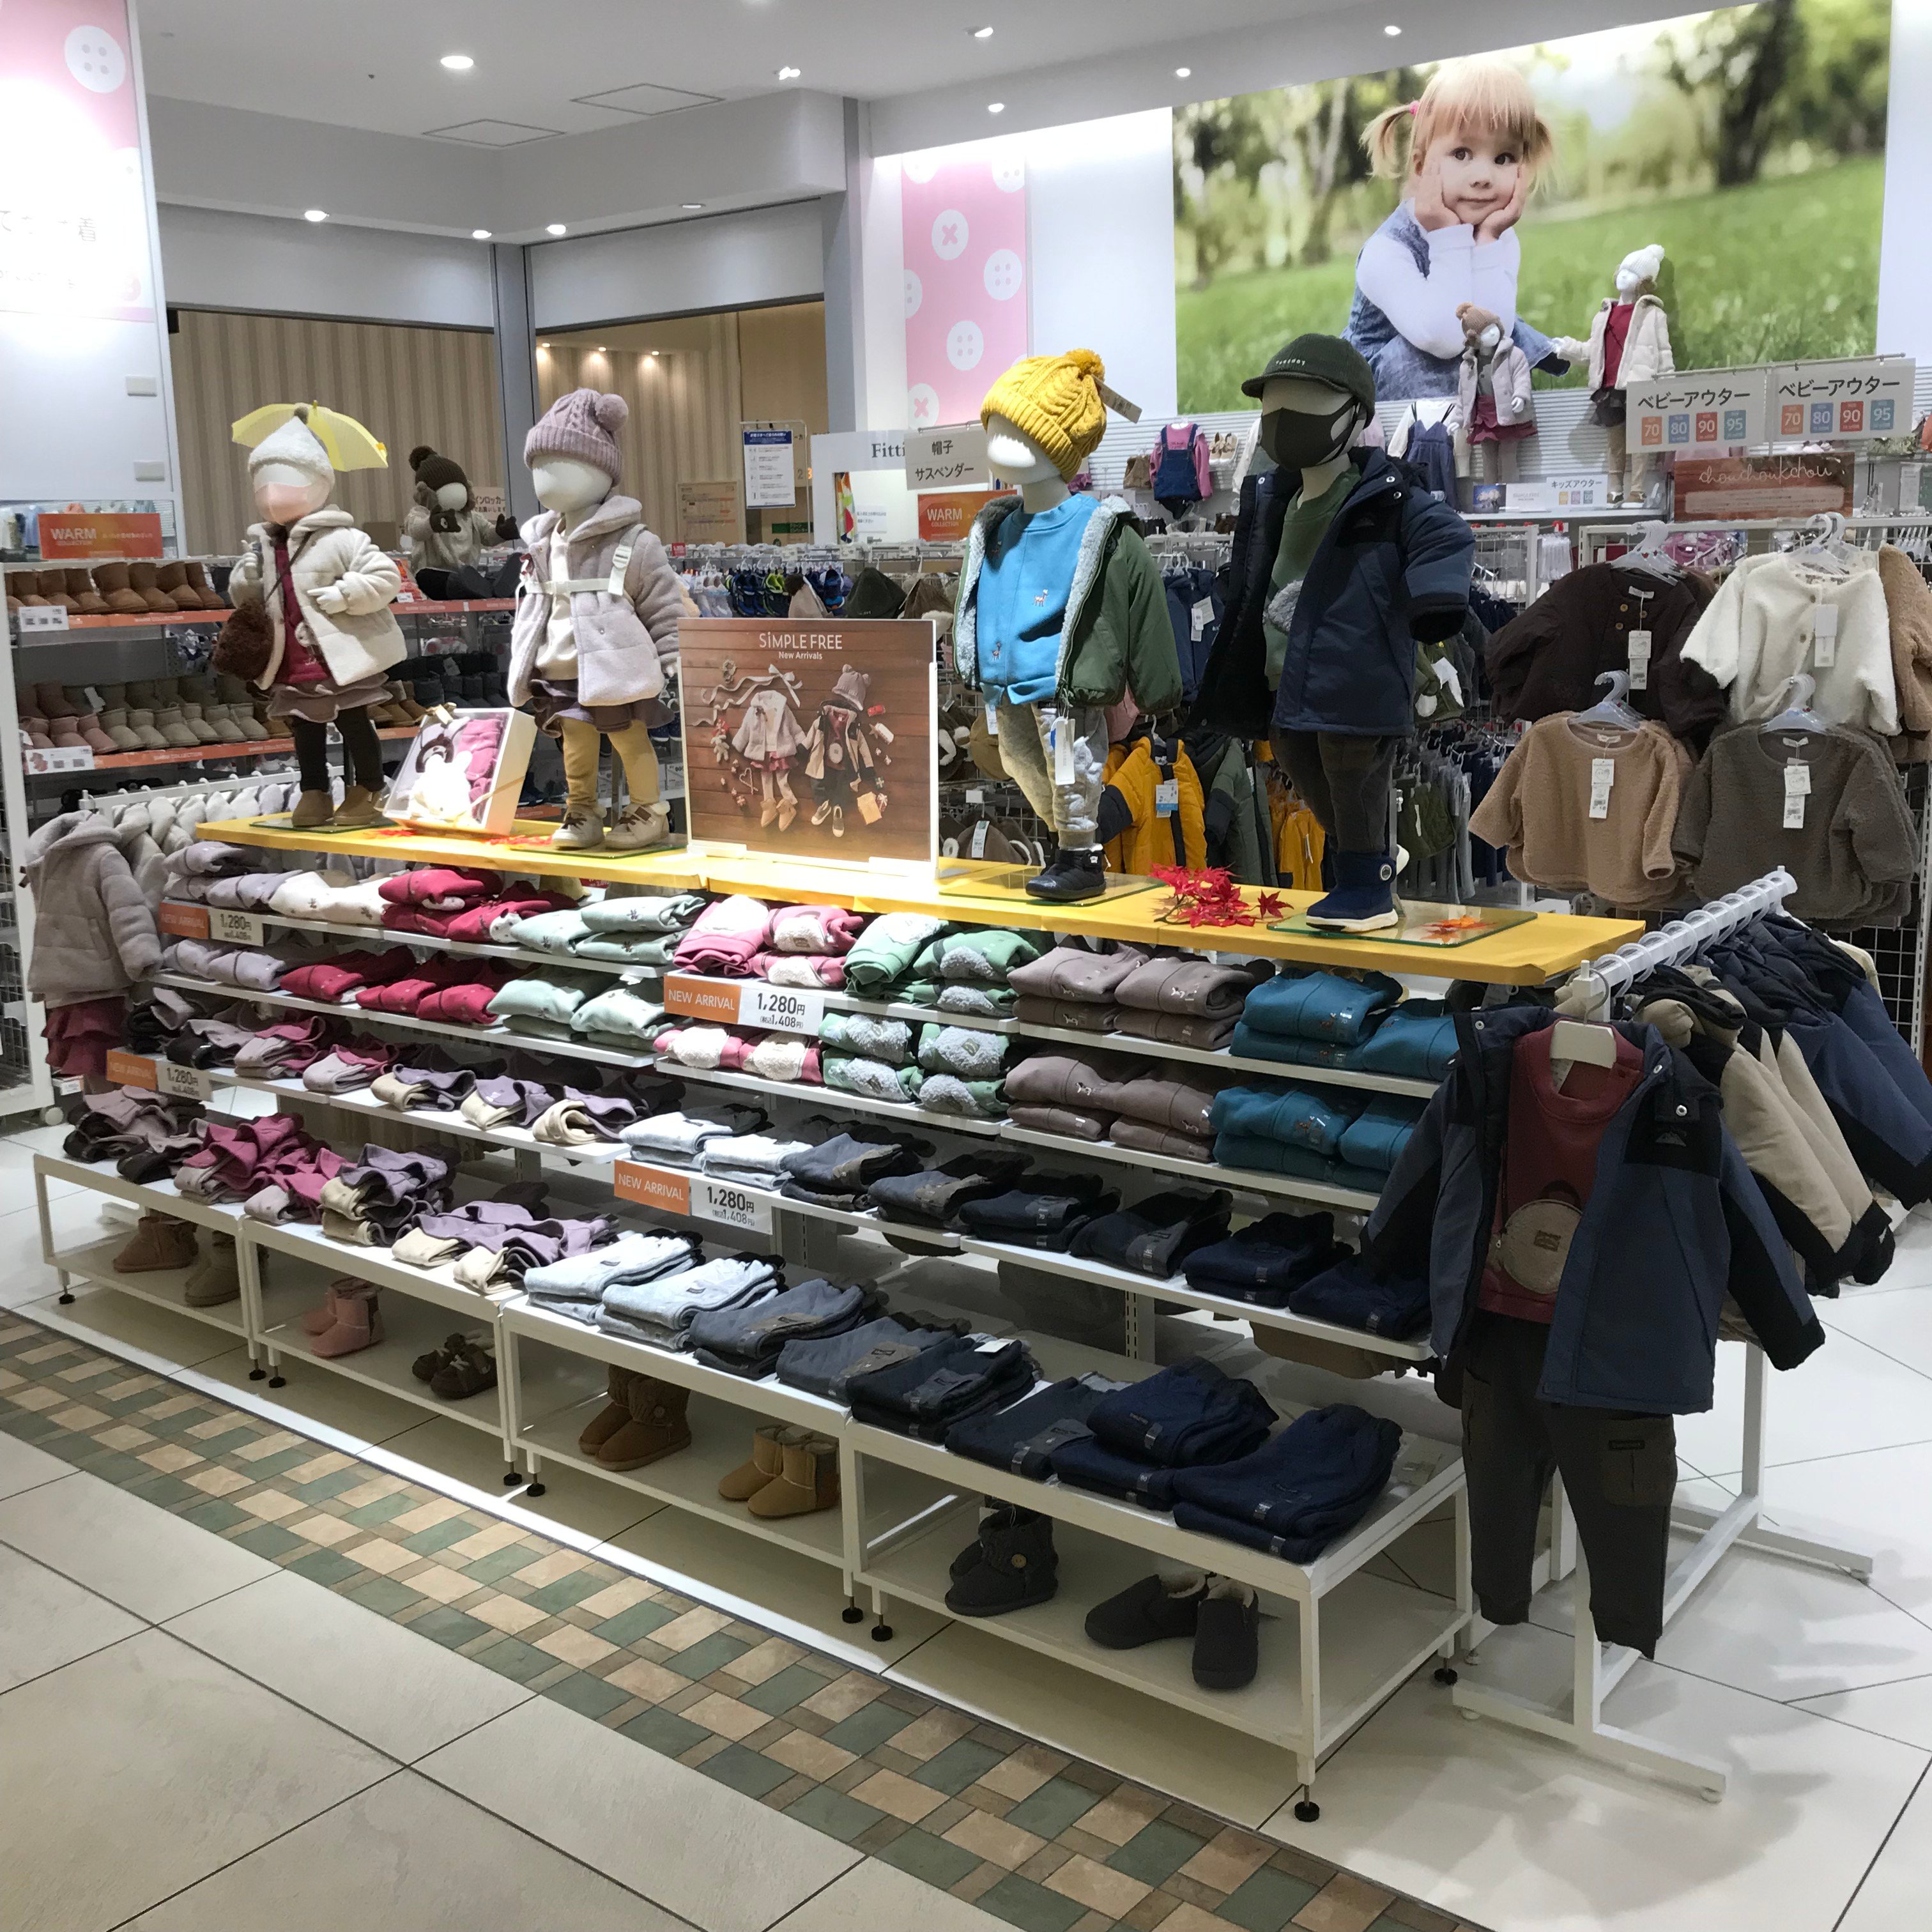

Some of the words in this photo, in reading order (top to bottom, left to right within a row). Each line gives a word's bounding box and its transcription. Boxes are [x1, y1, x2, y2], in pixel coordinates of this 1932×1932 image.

[1779, 376, 1900, 397] ベビーアウター
[1638, 388, 1751, 409] ベビーアウター
[1784, 412, 1801, 426] 70
[1813, 411, 1830, 424] 80
[1843, 409, 1860, 423] 90
[1873, 407, 1891, 422] 95
[1644, 424, 1660, 437] 70
[1671, 422, 1687, 435] 80
[1698, 419, 1715, 433] 90
[1726, 417, 1743, 432] 95
[931, 440, 953, 456] 帽子
[915, 463, 974, 481] サスペンダー
[1551, 479, 1602, 489] キッズアウター
[927, 508, 962, 521] WARM
[50, 528, 96, 540] WARM
[810, 634, 843, 649] FREE
[668, 989, 693, 1004] NEW
[694, 995, 735, 1010] ARRIVAL
[757, 993, 805, 1015] 1,280円
[618, 1173, 642, 1190] NEW
[644, 1180, 684, 1200] ARRIVAL
[707, 1186, 755, 1213] 1,280円
